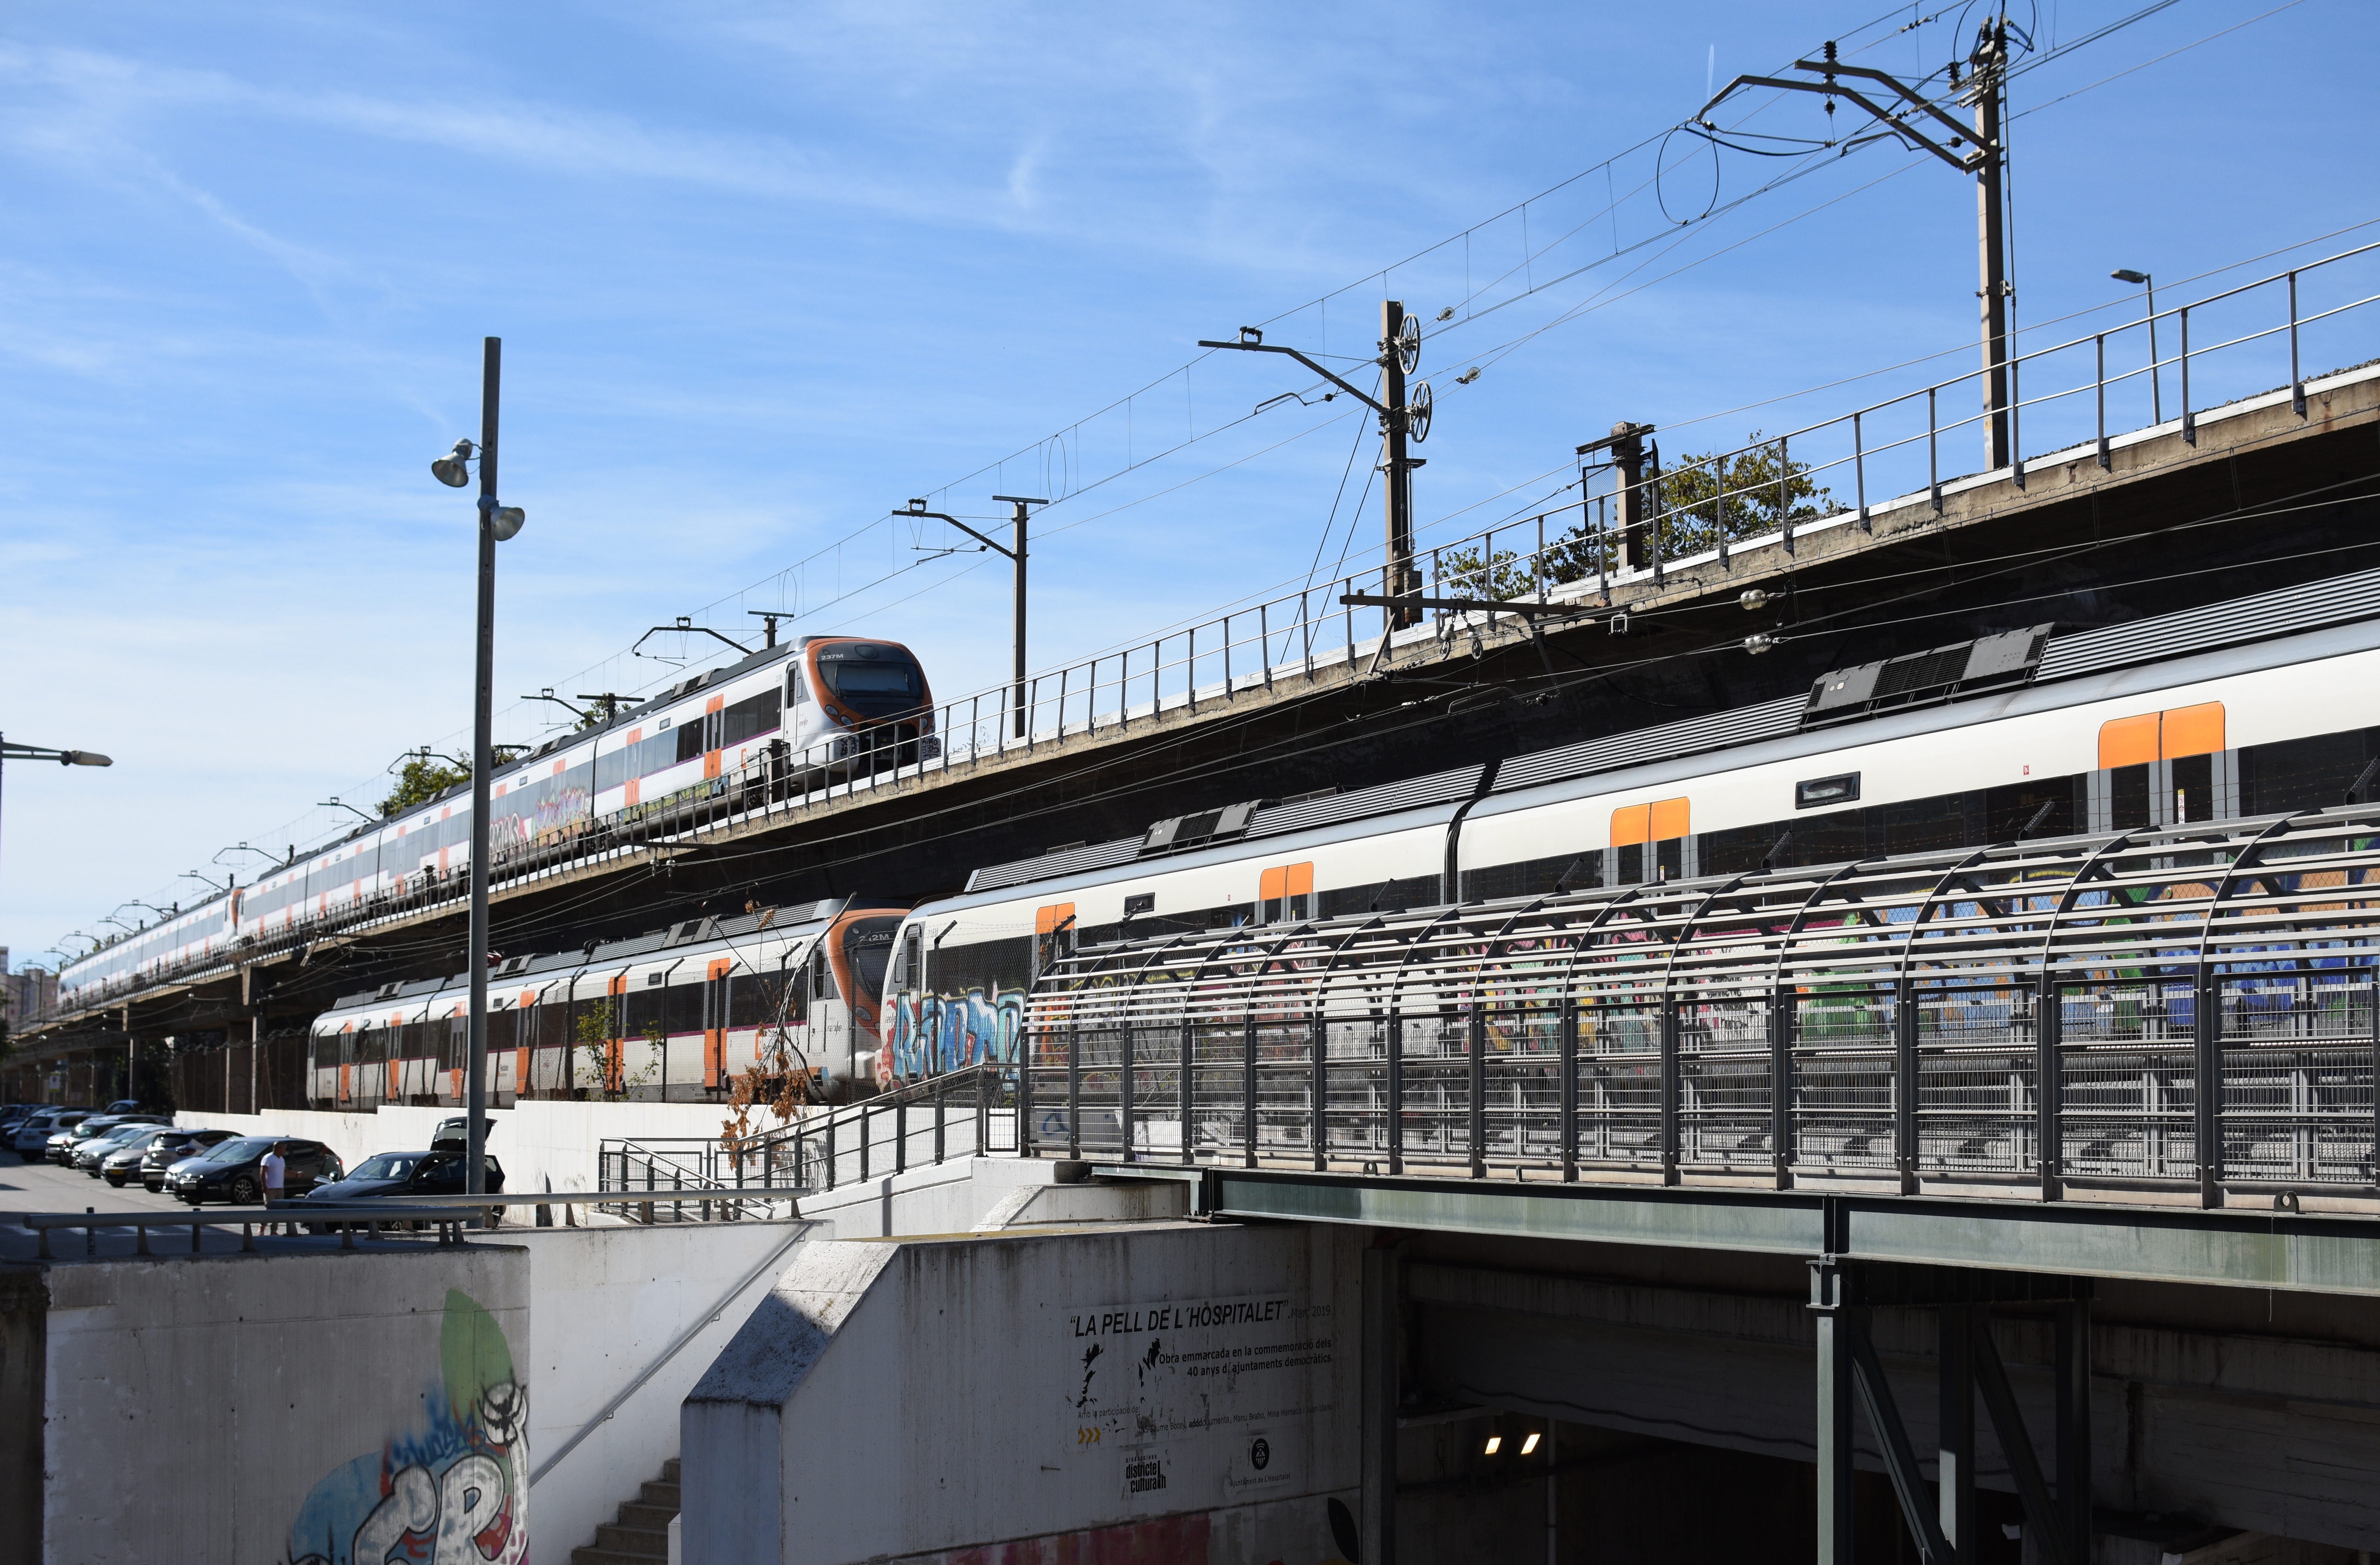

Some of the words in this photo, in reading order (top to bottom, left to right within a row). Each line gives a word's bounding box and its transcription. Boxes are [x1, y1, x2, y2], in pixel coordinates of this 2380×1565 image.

[799, 717, 808, 728] renfe
[827, 1021, 842, 1036] renfe
[1102, 1312, 1142, 1334] PELL
[1148, 1310, 1170, 1331] DE
[1312, 1305, 1333, 1317] 2019.
[1159, 1353, 1179, 1364] Obra
[1182, 1348, 1229, 1361] emmarcada
[1232, 1348, 1242, 1357] en
[1245, 1346, 1251, 1356] la
[1255, 1339, 1313, 1355] commemoració
[1316, 1338, 1331, 1349] dels
[1187, 1366, 1198, 1376] 40
[1201, 1366, 1219, 1377] anys
[1285, 1353, 1333, 1367] democràtics.
[1078, 1411, 1091, 1419] Amb
[1249, 1412, 1266, 1420] Brabo,
[1268, 1410, 1279, 1418] Mina
[1281, 1407, 1301, 1416] Hamada
[1126, 1461, 1157, 1479] districte
[1230, 1477, 1257, 1487] Ajuntament
